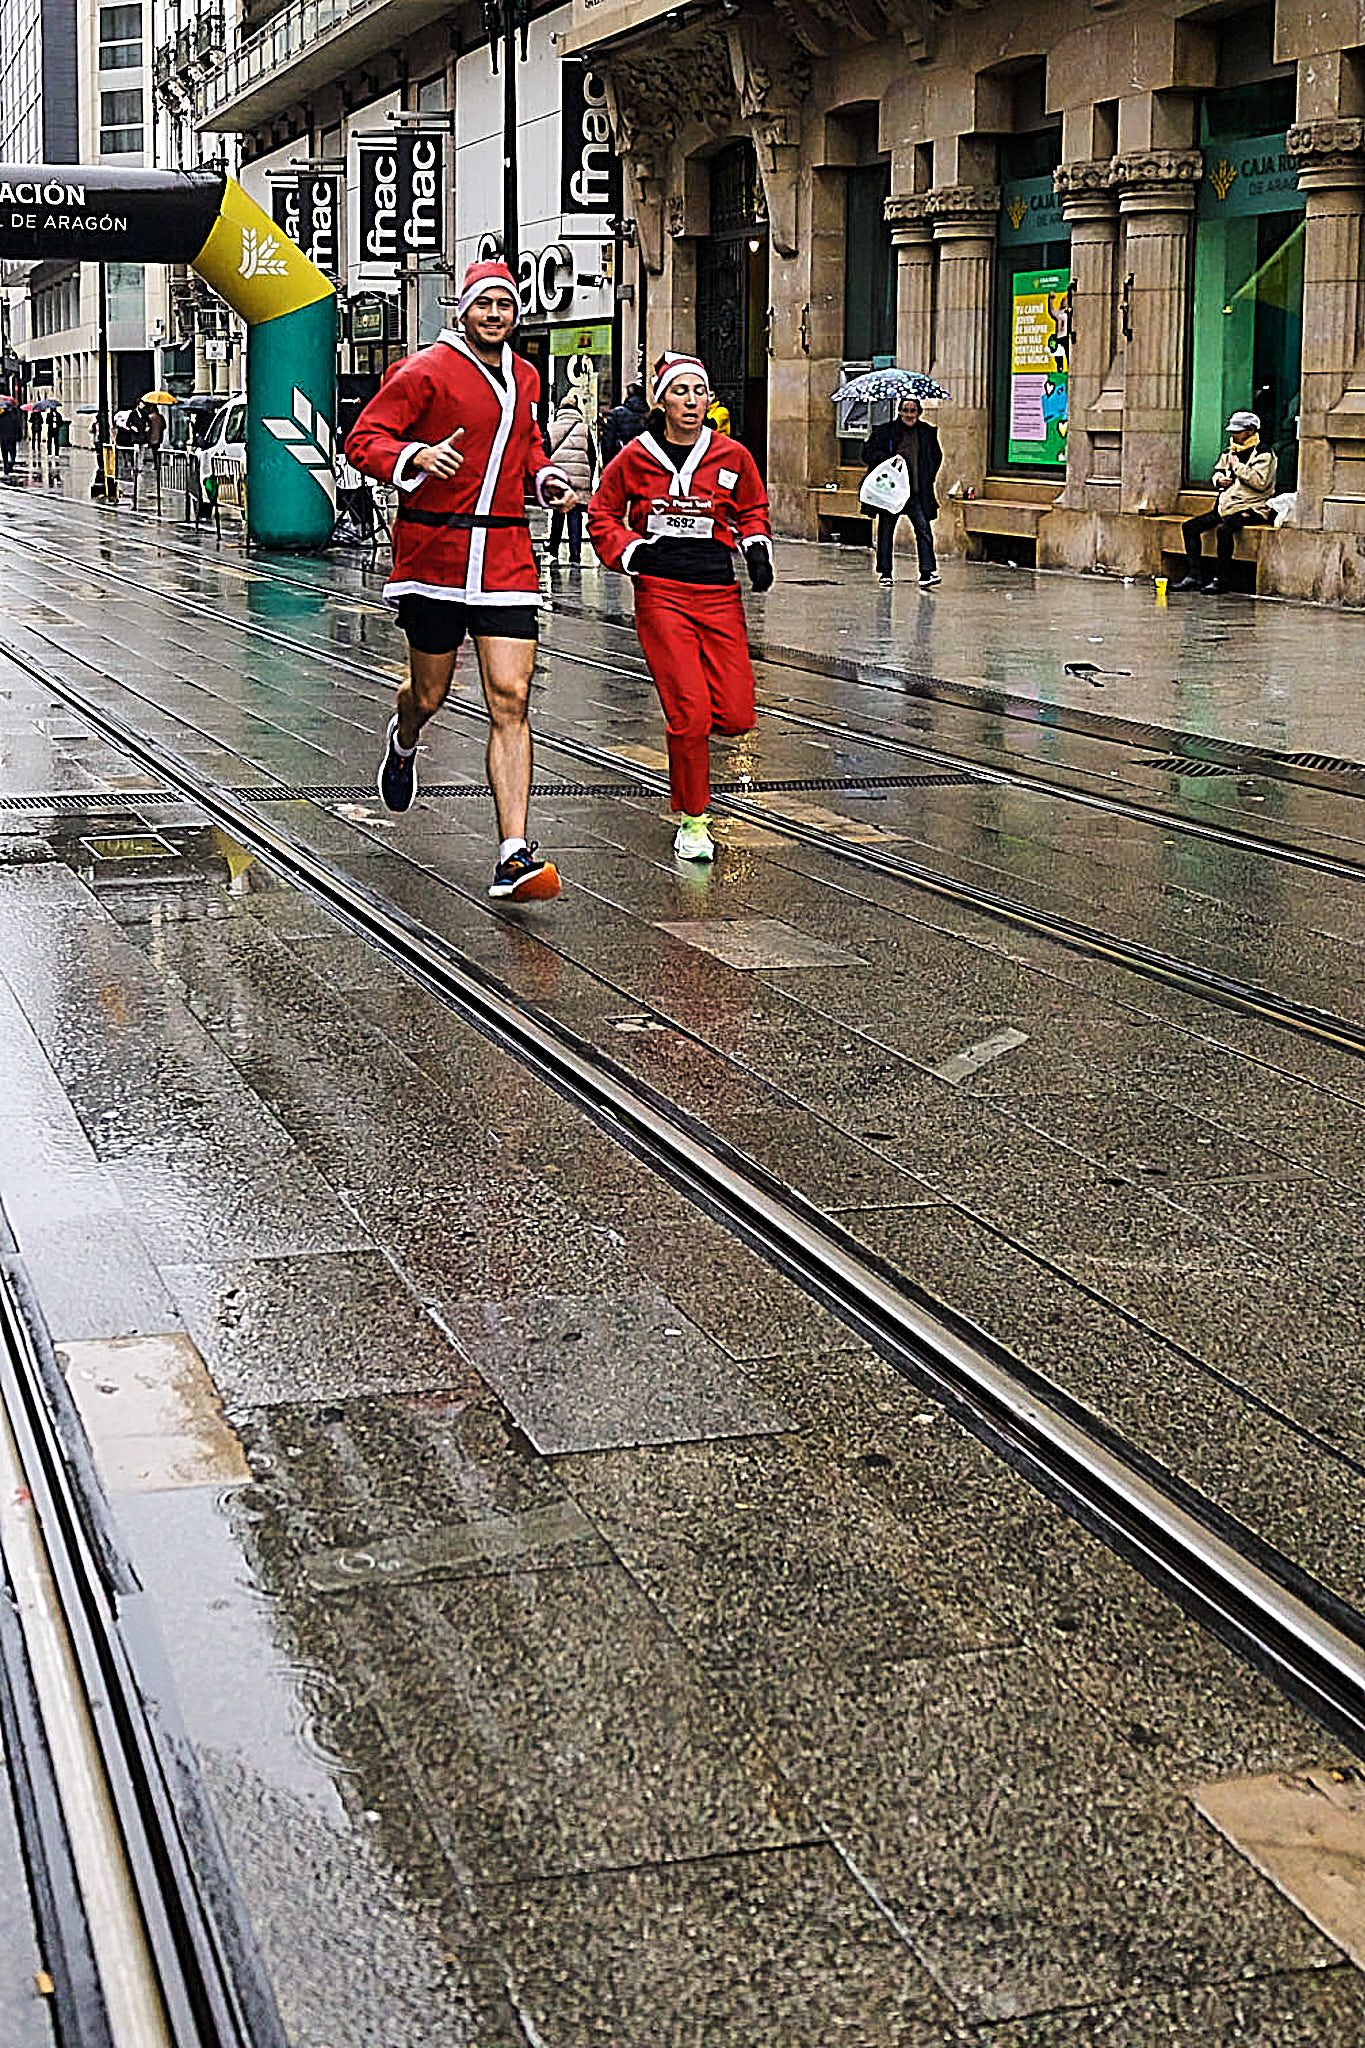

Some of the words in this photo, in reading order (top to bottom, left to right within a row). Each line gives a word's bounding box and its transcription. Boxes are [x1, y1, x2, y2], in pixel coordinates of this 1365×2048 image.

[570, 71, 610, 206] fnac
[1241, 155, 1276, 178] CAJA
[0, 178, 86, 206] ACIÓN
[403, 140, 436, 248] fnac
[1248, 181, 1265, 196] DE
[366, 155, 397, 257] fnac
[10, 213, 38, 229] DE
[43, 213, 127, 231] ARAGÓN
[666, 516, 696, 529] 2692
